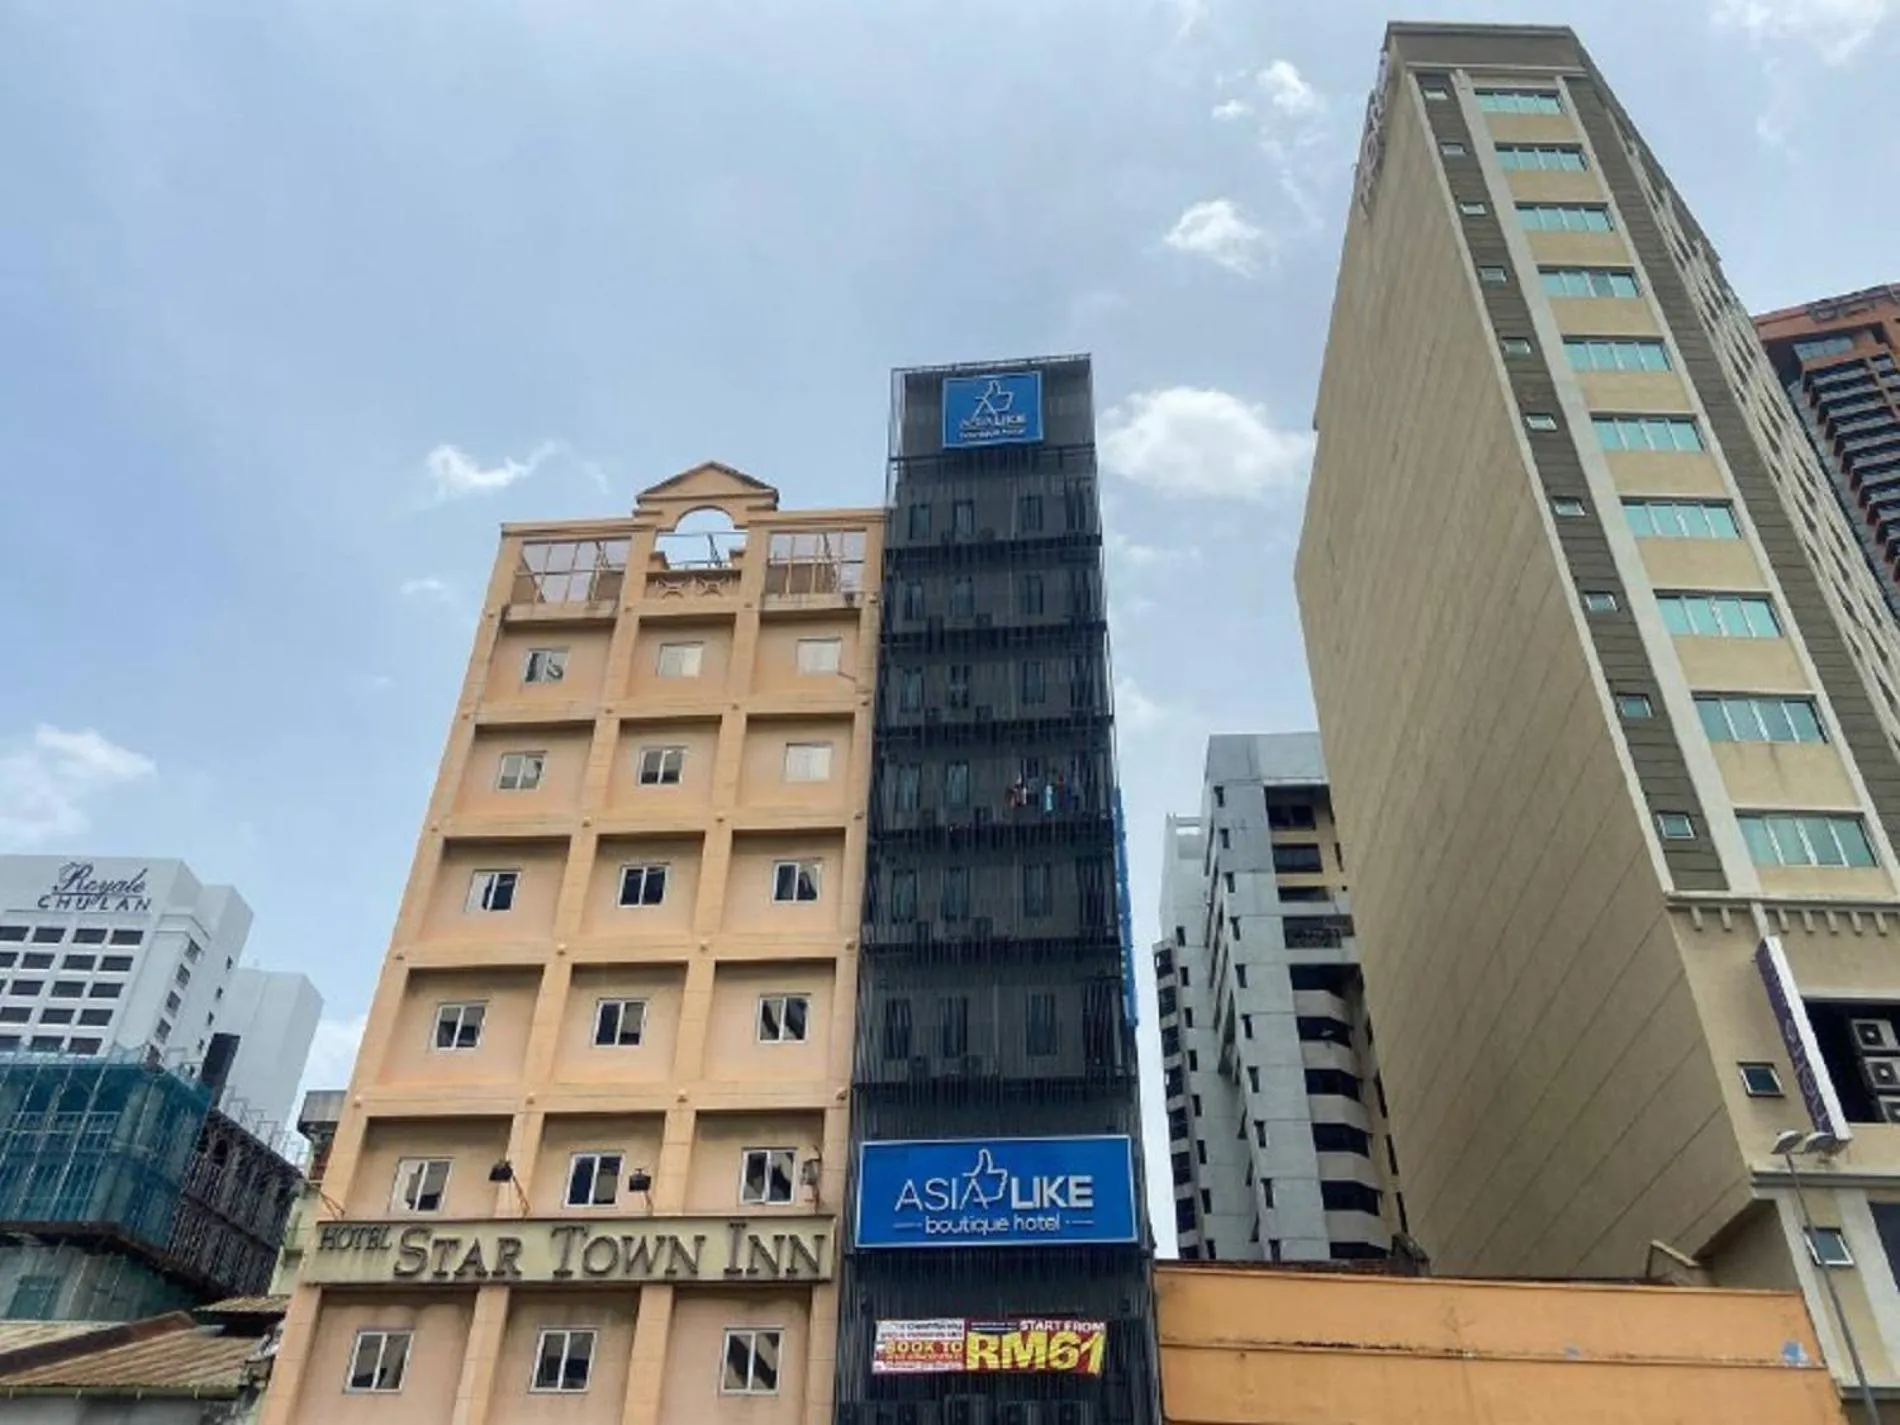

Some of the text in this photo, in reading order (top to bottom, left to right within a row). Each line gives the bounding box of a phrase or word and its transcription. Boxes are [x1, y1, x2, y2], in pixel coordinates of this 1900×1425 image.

[53, 861, 148, 904] Royale
[38, 895, 152, 911] CHULAN
[894, 1174, 1094, 1212] ASIA LIKE
[925, 1213, 1061, 1237] boutique hotel
[317, 1222, 826, 1278] HOTEL STAR TOWN INN
[1019, 1320, 1061, 1331] START
[1063, 1321, 1105, 1332] FROM
[966, 1331, 1105, 1374] RM61
